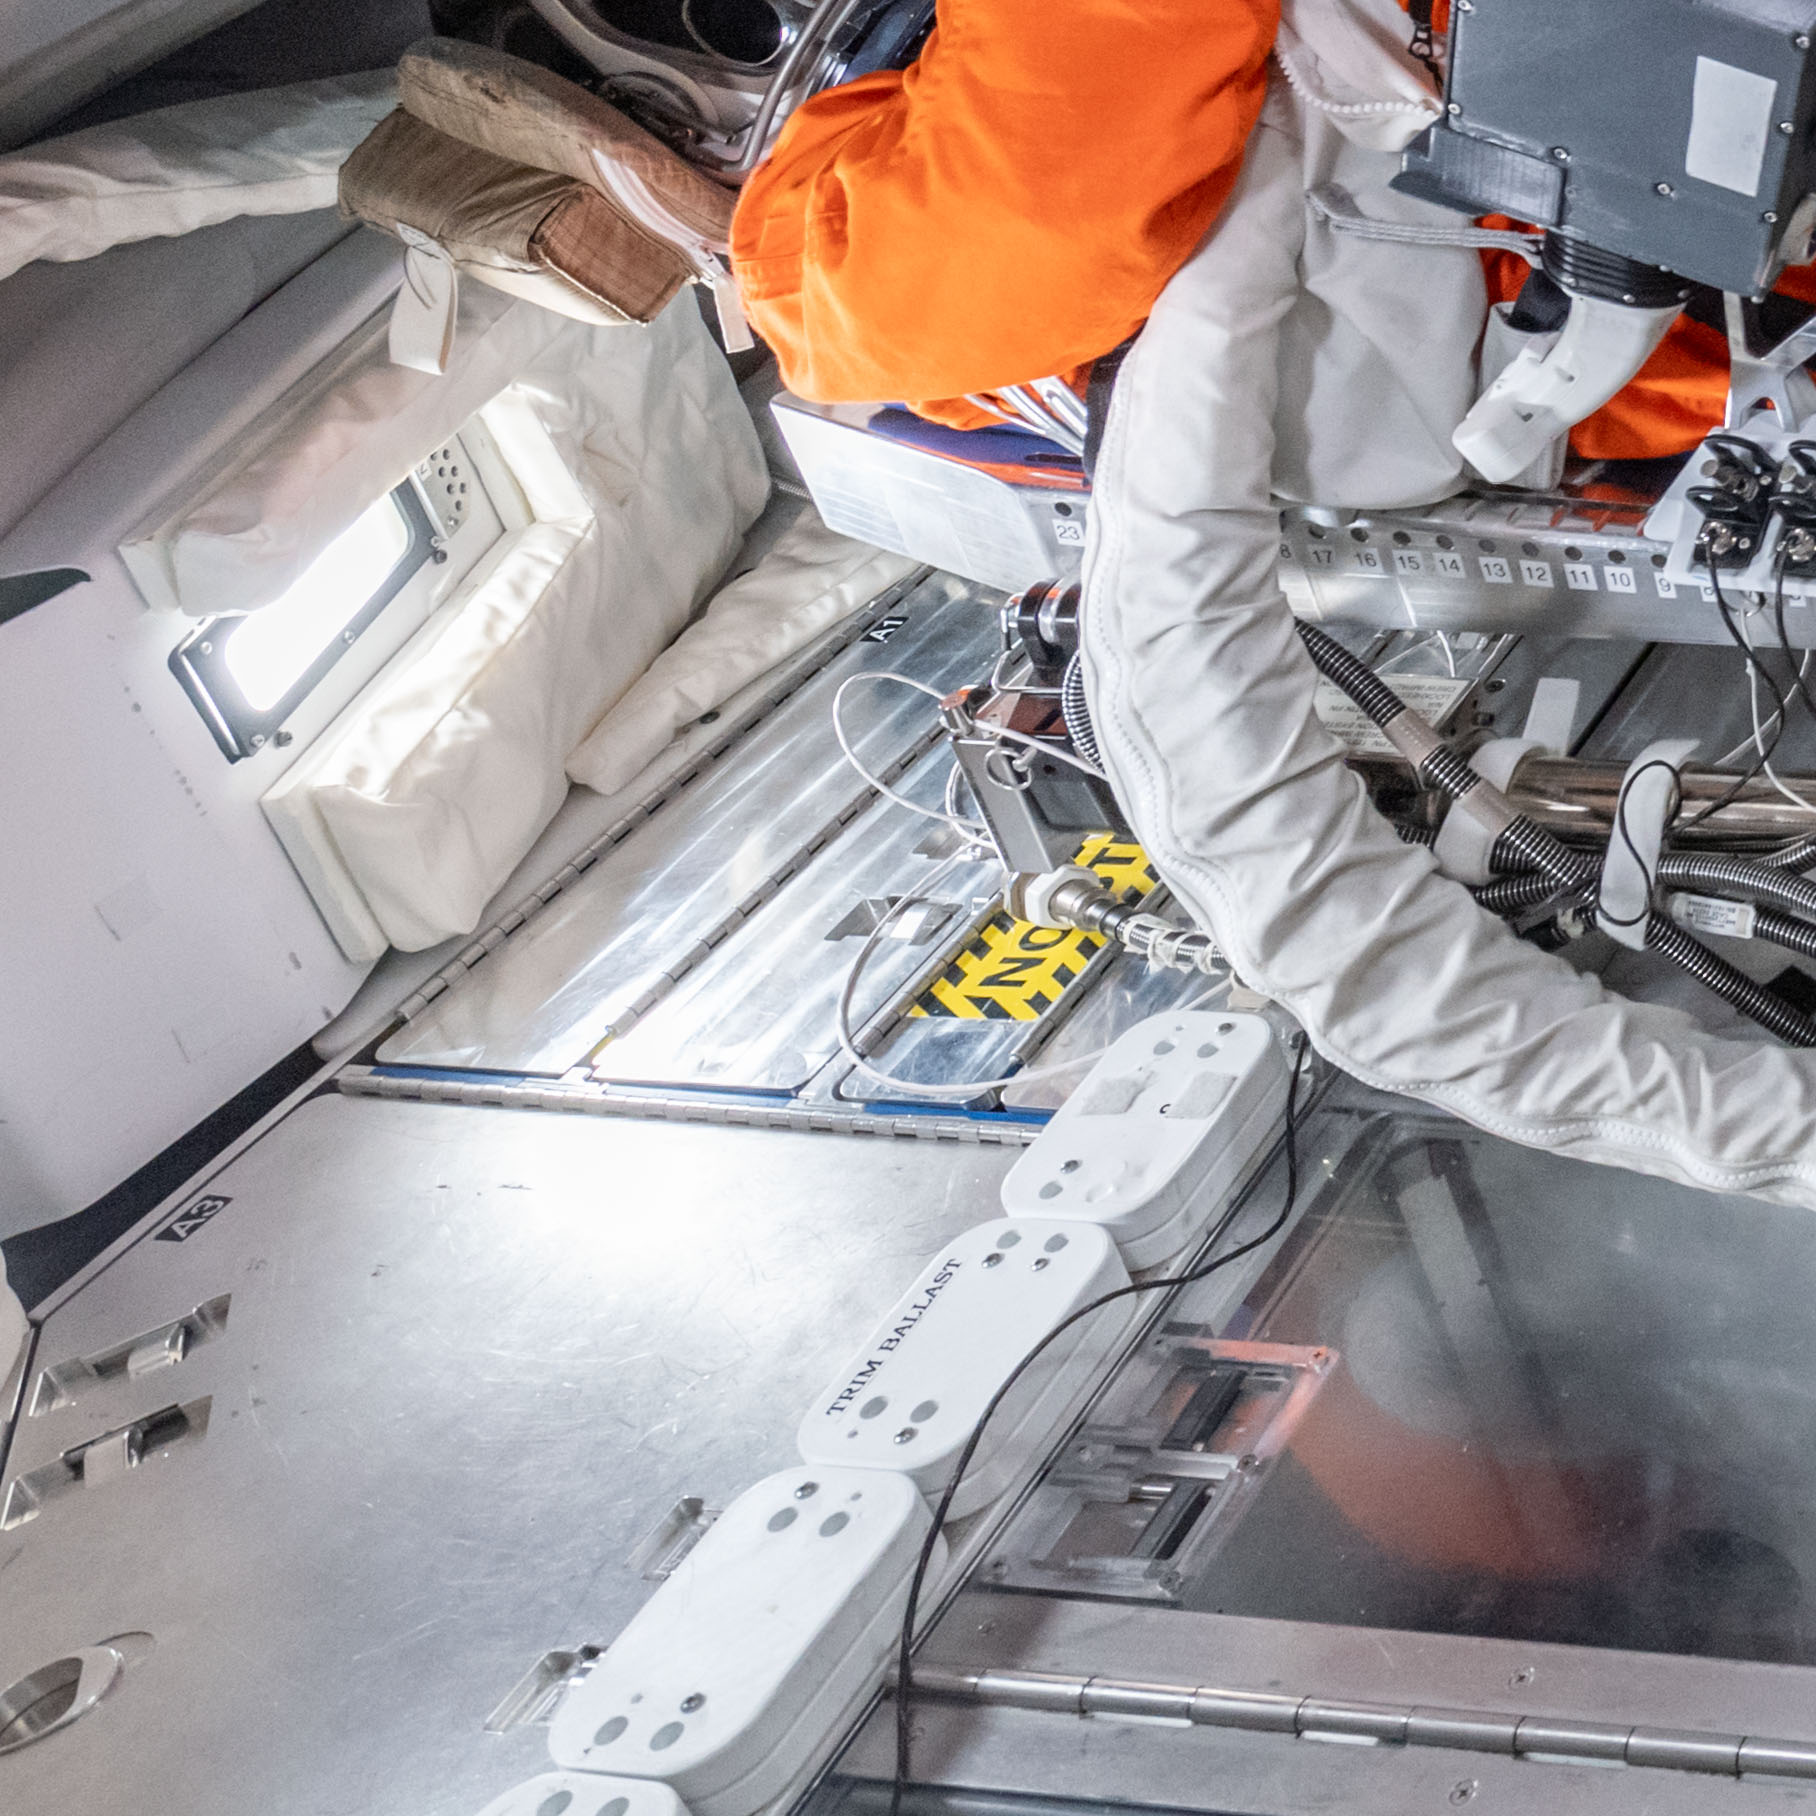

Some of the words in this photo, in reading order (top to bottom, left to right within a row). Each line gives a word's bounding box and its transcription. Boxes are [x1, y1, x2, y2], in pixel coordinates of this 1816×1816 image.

[1056, 525, 1081, 541] 23
[1312, 549, 1333, 565] 17
[1354, 552, 1378, 568] 16
[1397, 555, 1420, 571] 15
[1438, 557, 1461, 573] 14
[1484, 563, 1507, 579] 13
[1525, 566, 1548, 582] 12
[1569, 569, 1590, 585] 11
[1610, 572, 1631, 588] 10
[1658, 577, 1671, 593] 9
[870, 617, 903, 642] A1
[170, 1199, 224, 1238] A3
[824, 1358, 884, 1413] TRIM
[876, 1256, 963, 1354] BALLAST
